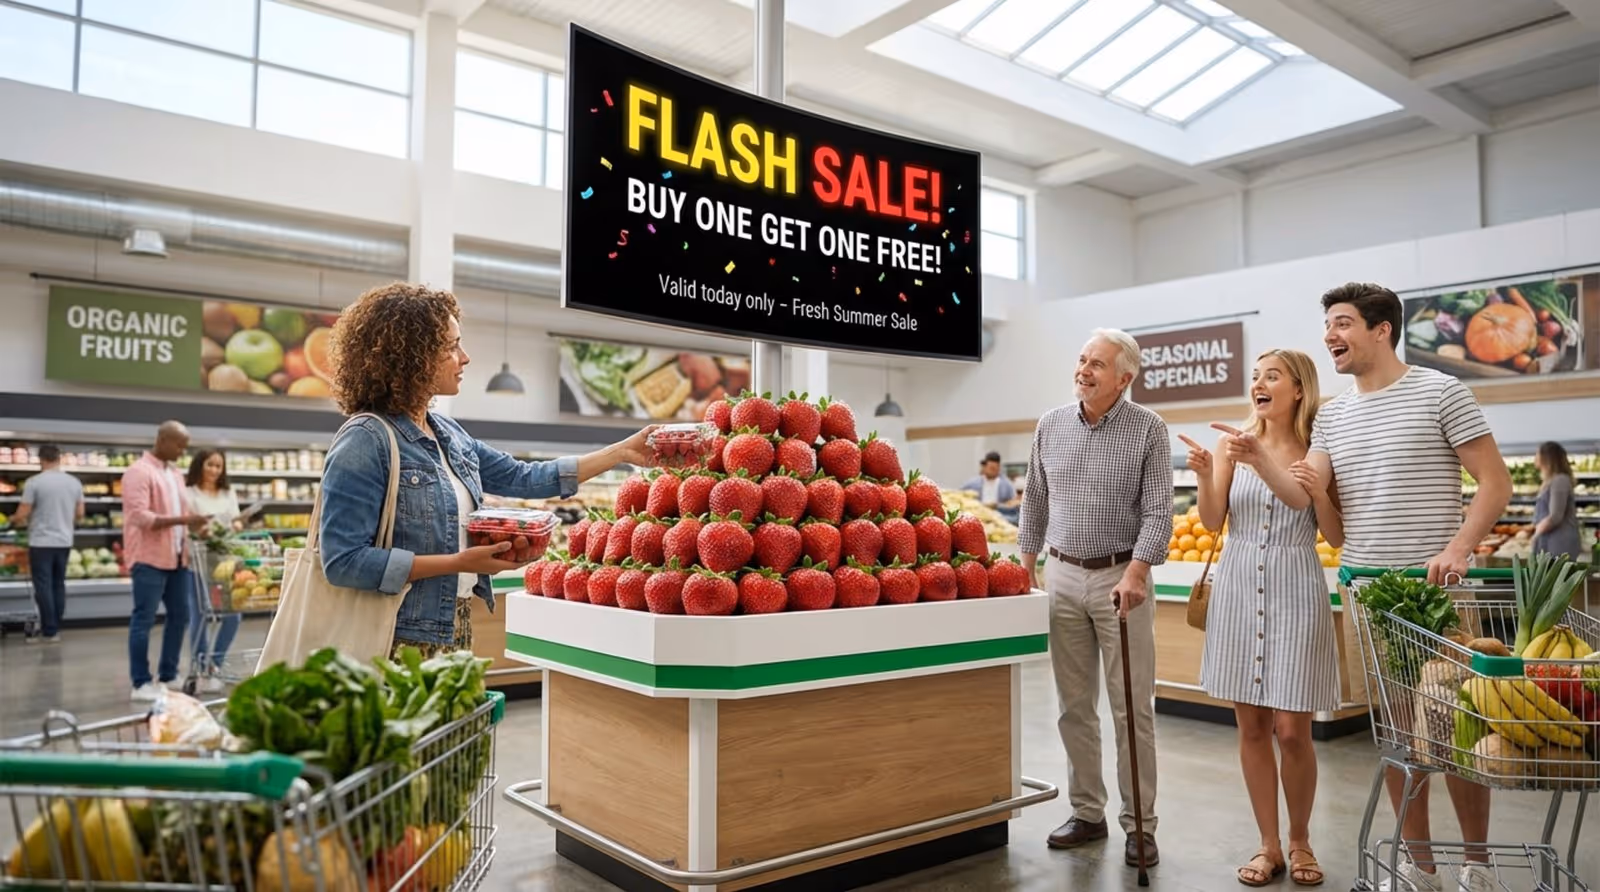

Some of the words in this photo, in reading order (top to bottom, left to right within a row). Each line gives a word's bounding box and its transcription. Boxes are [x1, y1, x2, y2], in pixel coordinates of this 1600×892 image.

[628, 84, 797, 195] FLASH
[812, 145, 941, 224] SALE!
[626, 177, 688, 224] BUY
[694, 196, 753, 241] ONE
[760, 212, 812, 252] GET
[818, 225, 871, 264] ONE
[876, 236, 943, 274] FREE!
[658, 272, 698, 300] Valid
[700, 283, 742, 312] today
[745, 292, 775, 317] only
[792, 297, 830, 321] Fresh
[833, 304, 888, 328] Summer
[890, 311, 919, 332] Sale
[66, 304, 188, 339] ORGANIC
[79, 332, 174, 364] FRUITS
[1140, 338, 1234, 368] SEASONAL
[1143, 362, 1229, 390] SPECIALS
